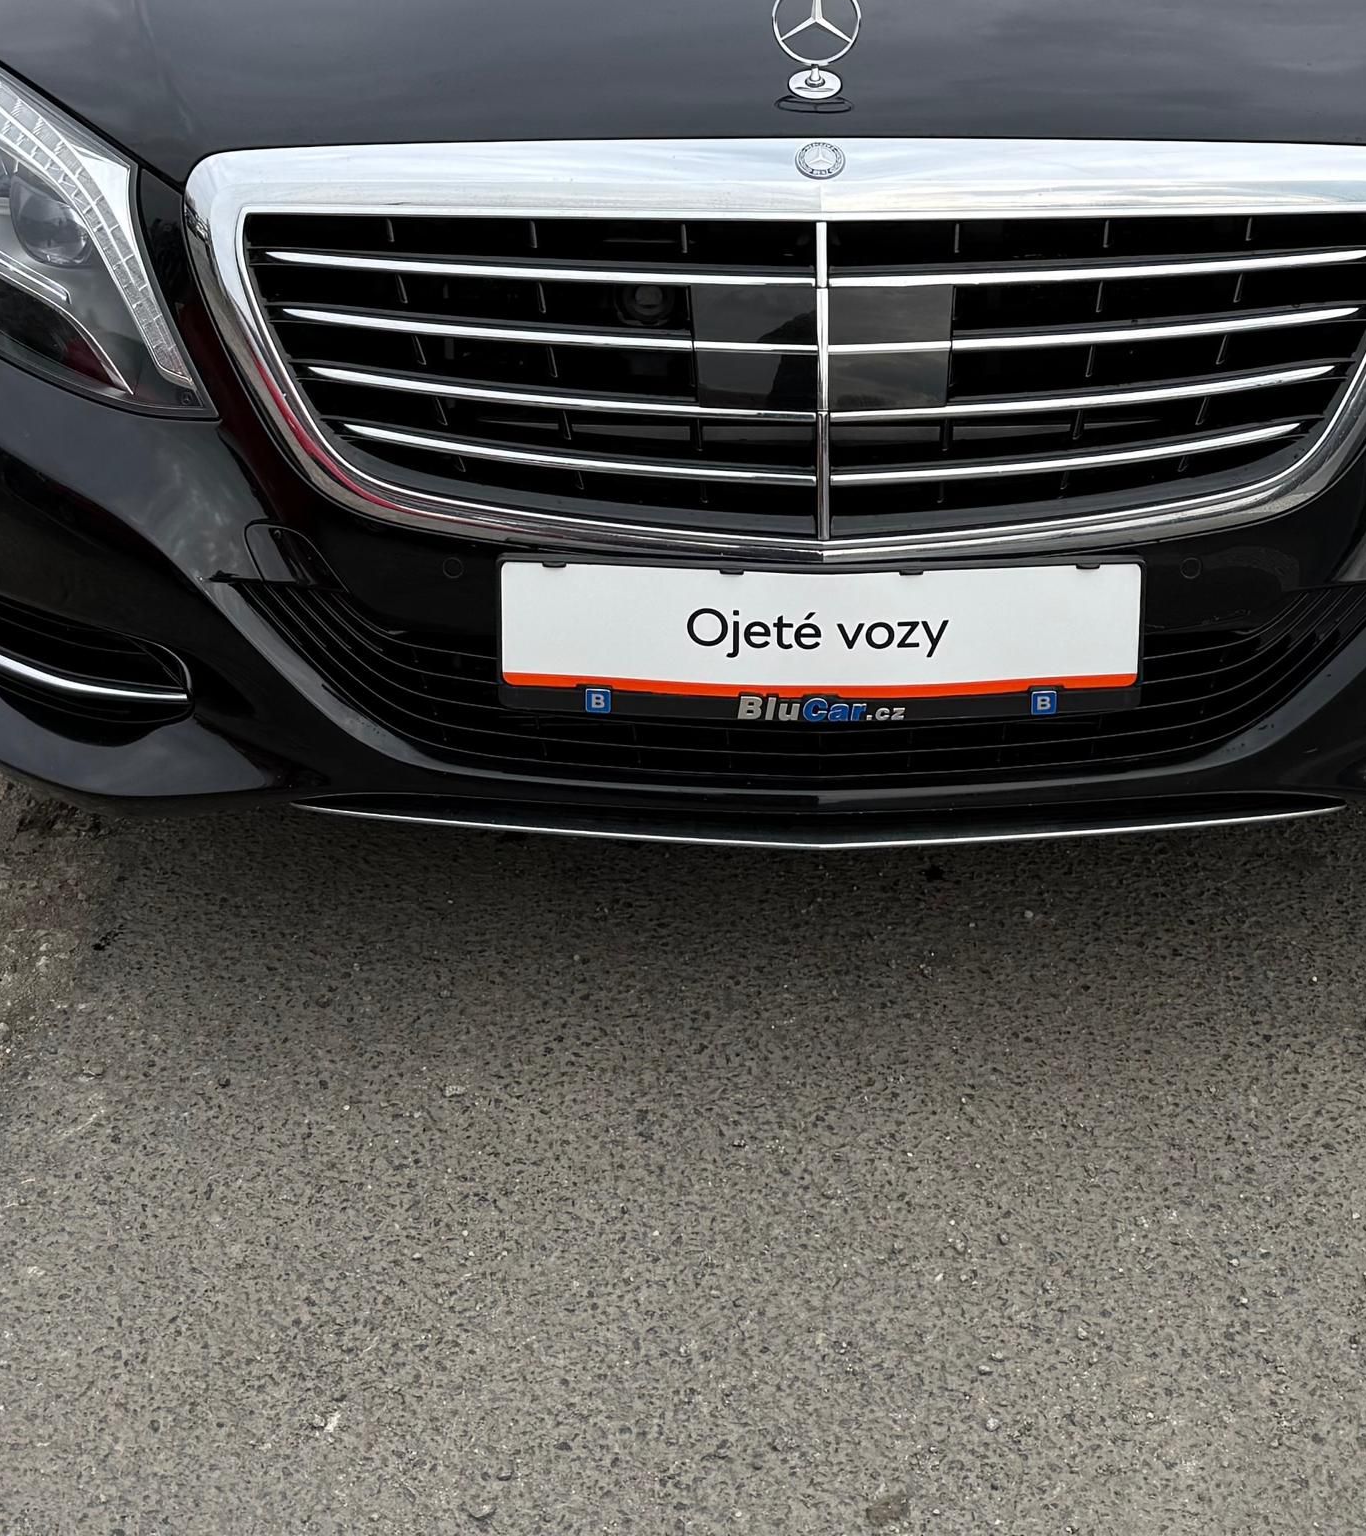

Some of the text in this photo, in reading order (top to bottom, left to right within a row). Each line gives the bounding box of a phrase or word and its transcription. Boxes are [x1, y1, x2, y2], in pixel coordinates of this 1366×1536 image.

[686, 607, 949, 659] Ojeté vozy
[591, 692, 605, 707] B
[737, 695, 906, 722] BluCar.cz
[1036, 695, 1051, 710] B
